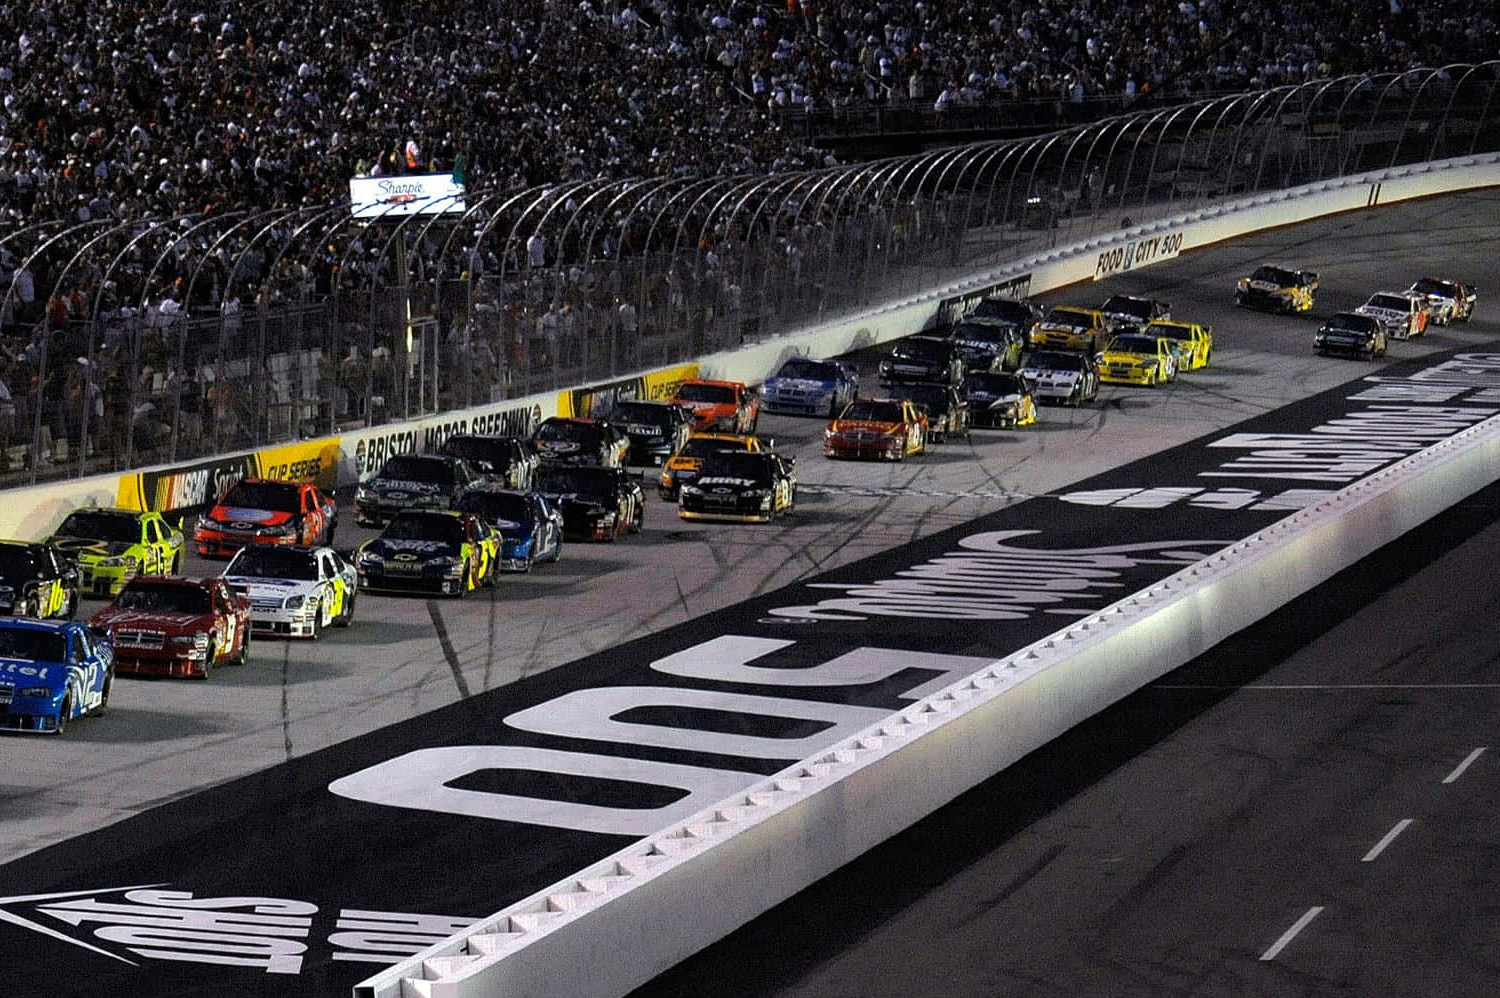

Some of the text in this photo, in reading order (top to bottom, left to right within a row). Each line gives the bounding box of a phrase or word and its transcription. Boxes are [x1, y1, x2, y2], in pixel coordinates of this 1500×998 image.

[378, 180, 425, 195] Sharpie
[1096, 232, 1183, 275] FOOD CITY 500
[212, 464, 245, 503] Sprint
[327, 634, 1003, 837] 500
